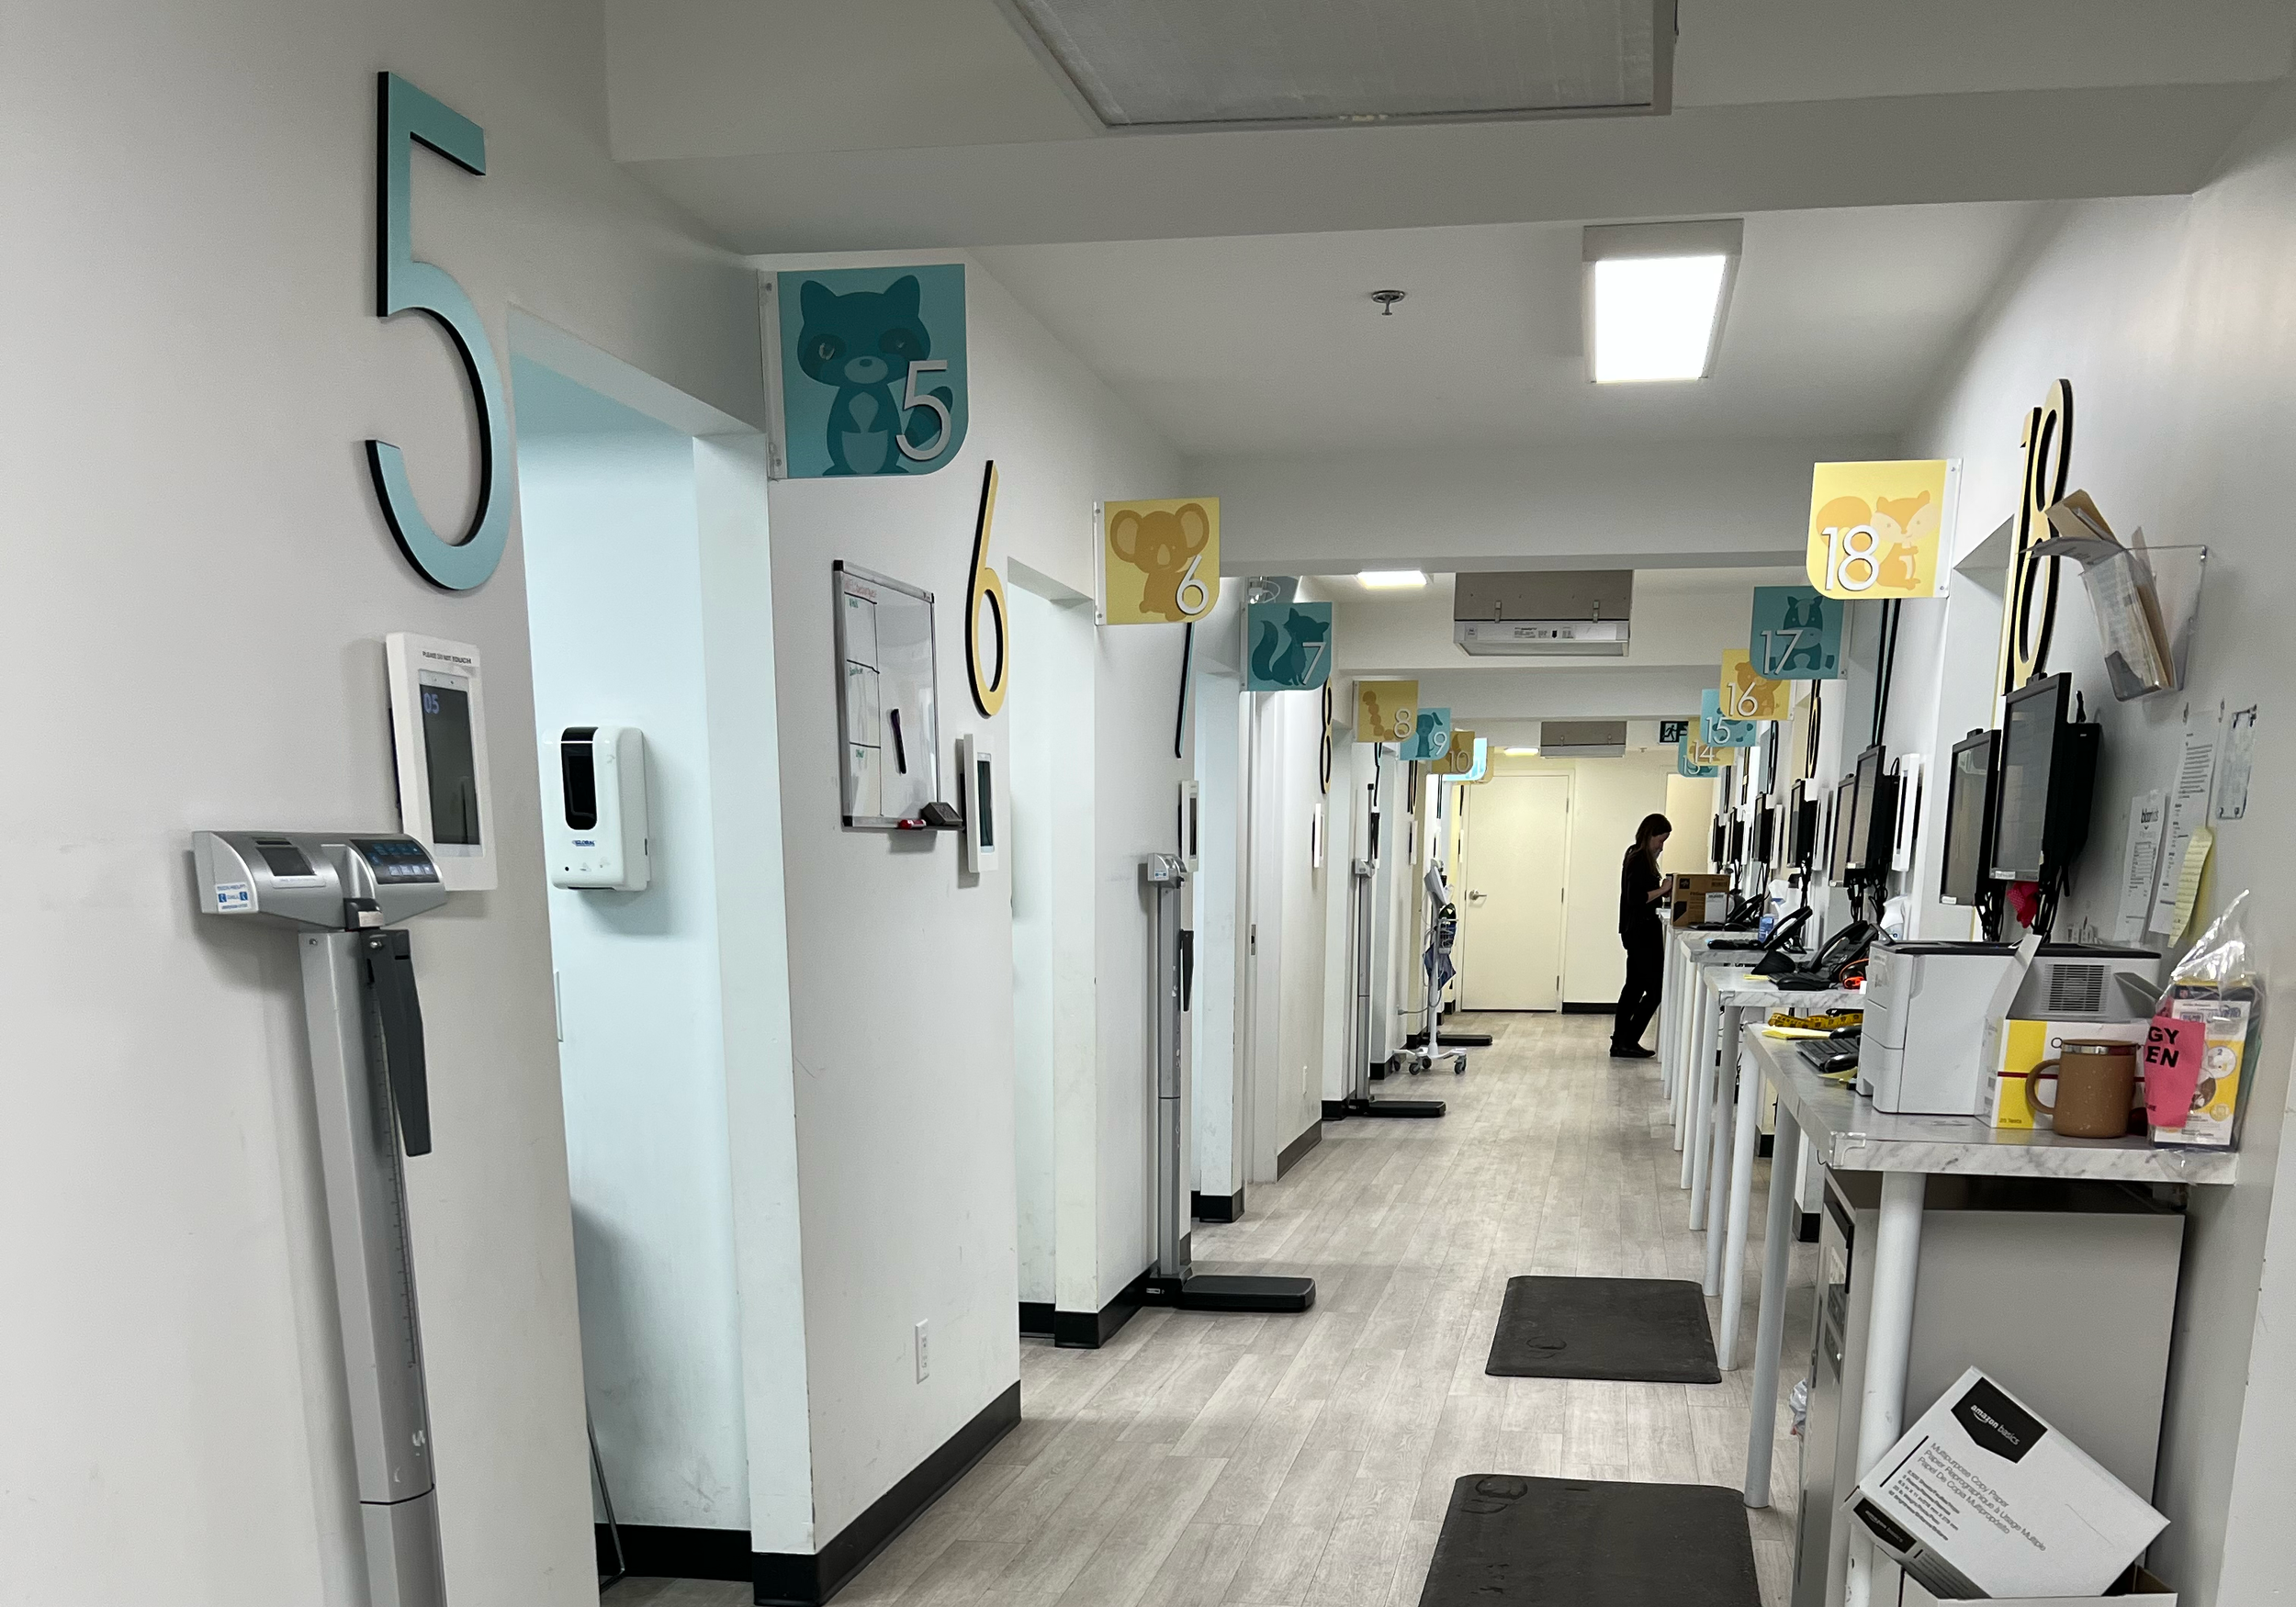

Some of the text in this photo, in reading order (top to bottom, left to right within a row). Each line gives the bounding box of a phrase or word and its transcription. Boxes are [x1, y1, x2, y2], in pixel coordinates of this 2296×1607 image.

[366, 72, 512, 590] 5
[895, 360, 951, 461] 5
[1821, 524, 1879, 591] 18
[965, 460, 1009, 718] 6
[1176, 555, 1209, 615] 6
[453, 656, 472, 664] TOUCH
[1301, 642, 1326, 685] 7
[1761, 629, 1806, 675] 17
[423, 692, 439, 714] 05
[1727, 682, 1758, 716] 16
[1393, 708, 1411, 738] 8
[1433, 731, 1447, 756] 9
[1706, 717, 1730, 745] 15
[1449, 751, 1469, 773] 10
[1693, 739, 1715, 764] 14
[1971, 1404, 2020, 1445] amazon basics
[1918, 1456, 1938, 1475] Papel
[1936, 1471, 1947, 1483] De
[1947, 1480, 1966, 1499] Copia
[1931, 1443, 2009, 1507] Multipurpose Copy Paper
